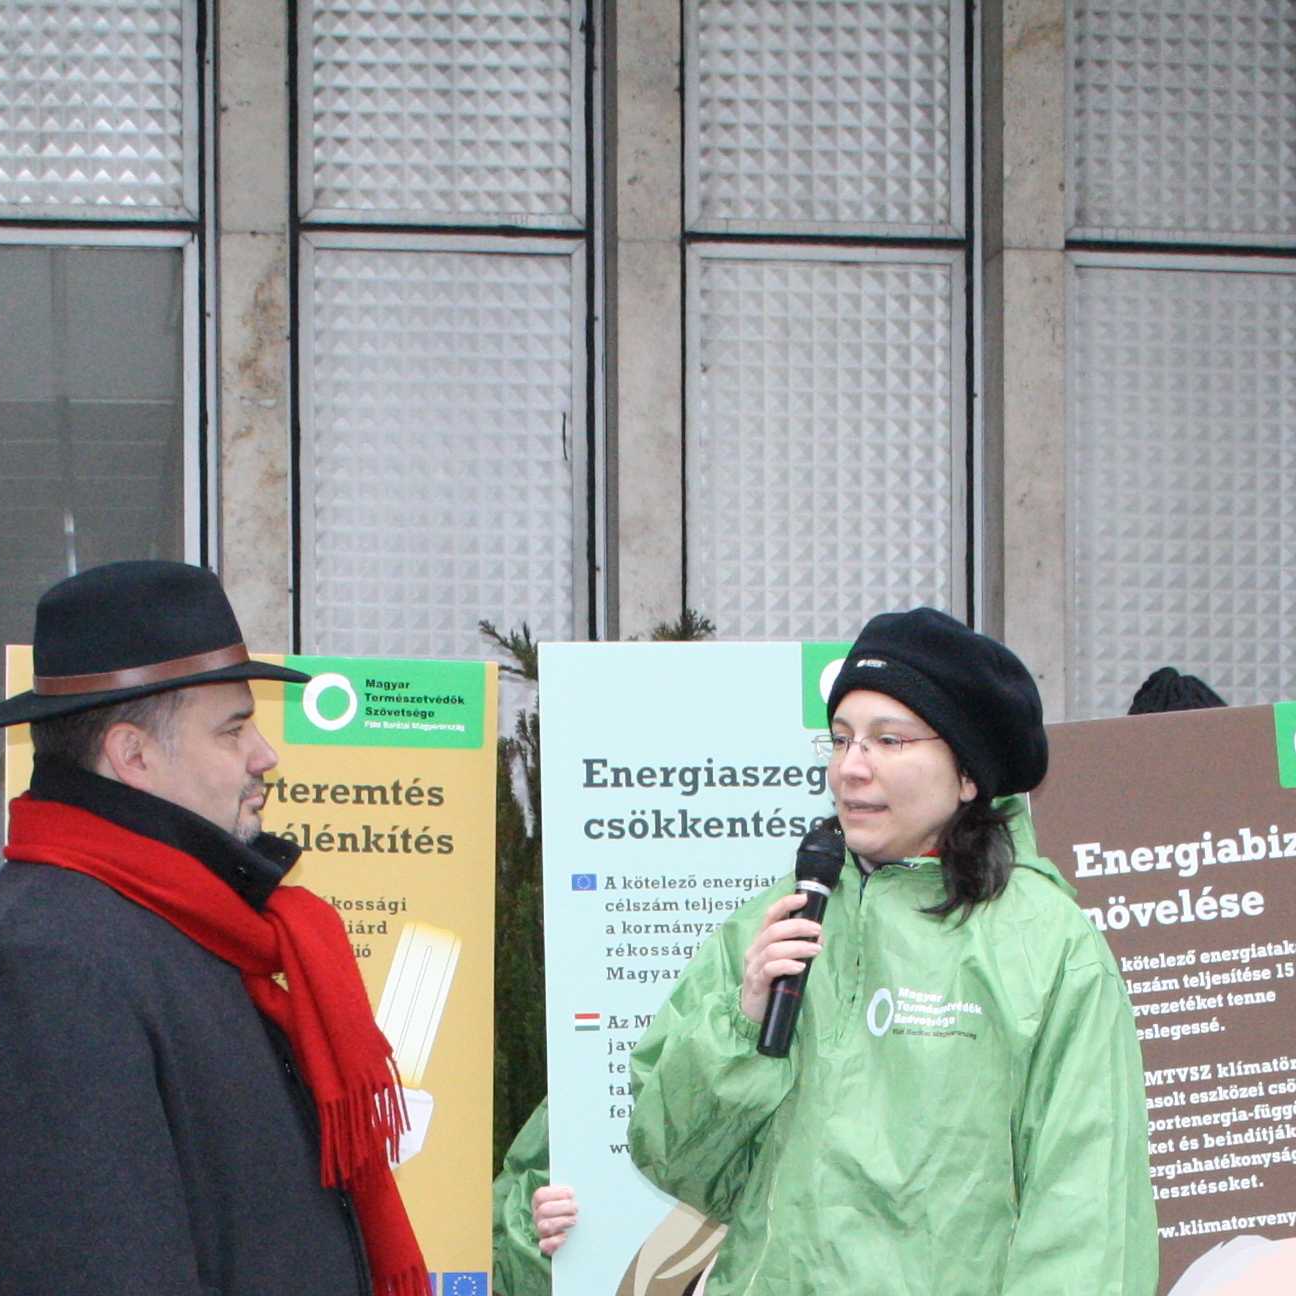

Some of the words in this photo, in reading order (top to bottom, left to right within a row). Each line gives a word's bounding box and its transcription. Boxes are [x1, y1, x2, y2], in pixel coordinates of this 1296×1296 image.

[365, 679, 411, 691] Magyar
[582, 758, 828, 796] Energiaszeg
[263, 776, 445, 810] yteremtés
[271, 823, 454, 854] élénkítés
[604, 876, 616, 890] A
[622, 875, 697, 890] kötelező
[703, 874, 777, 891] energiat
[328, 896, 407, 915] kossági
[605, 898, 679, 913] célszám
[685, 896, 749, 913] teljesít
[1080, 886, 1265, 932] növelése
[606, 924, 615, 935] a
[1121, 949, 1196, 972] kötelező
[606, 966, 681, 983] Magyar
[1126, 973, 1180, 995] lszám
[1183, 967, 1271, 990] teljesítése
[1276, 963, 1294, 979] 15
[1132, 993, 1224, 1016] zvezetéket
[1227, 989, 1276, 1008] tenne
[607, 1015, 629, 1029] Az
[1136, 1017, 1226, 1040] eslegessé.
[608, 1038, 637, 1055] jav
[1144, 1065, 1212, 1086] MTVSZ
[1146, 1091, 1186, 1109] asolt
[1190, 1082, 1265, 1103] eszközei
[1148, 1141, 1175, 1155] ket
[1179, 1137, 1199, 1151] és
[1203, 1125, 1296, 1148] beindítják
[1153, 1174, 1264, 1200] lesztéseket.
